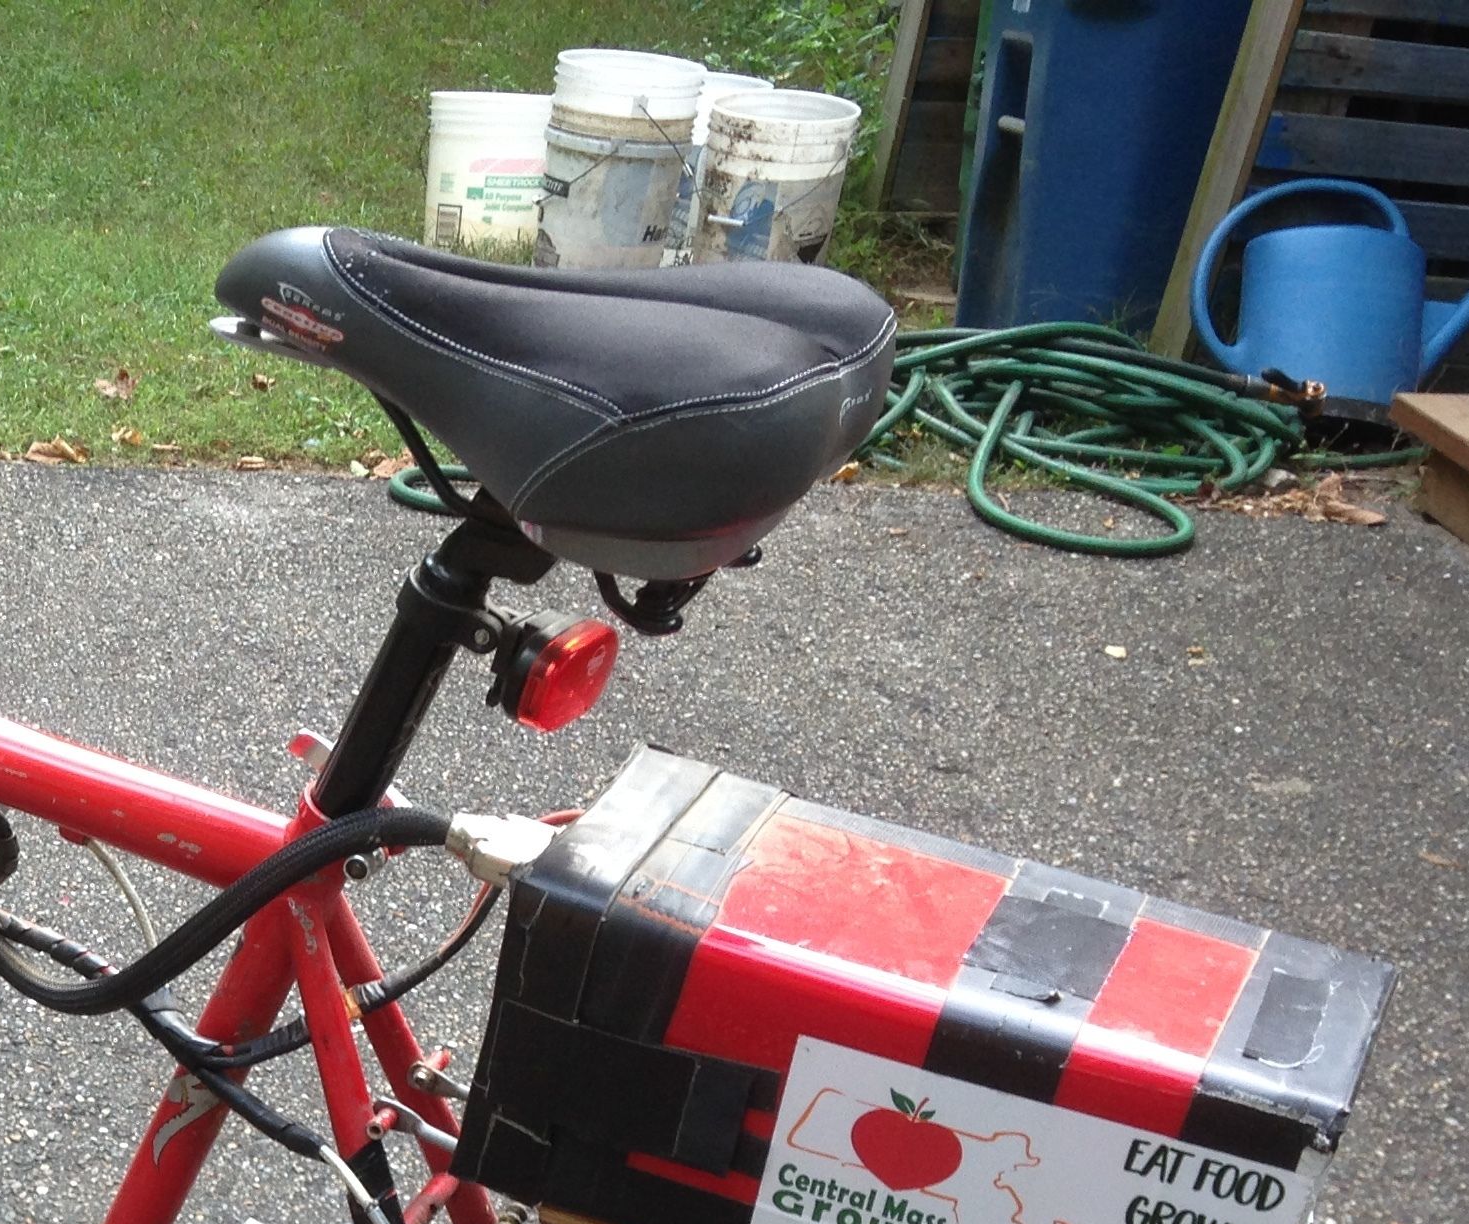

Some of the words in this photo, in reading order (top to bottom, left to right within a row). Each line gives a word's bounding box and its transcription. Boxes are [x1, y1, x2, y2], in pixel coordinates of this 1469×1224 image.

[778, 1162, 878, 1213] Central
[1124, 1138, 1196, 1185] EAT
[1192, 1158, 1286, 1212] FOOD
